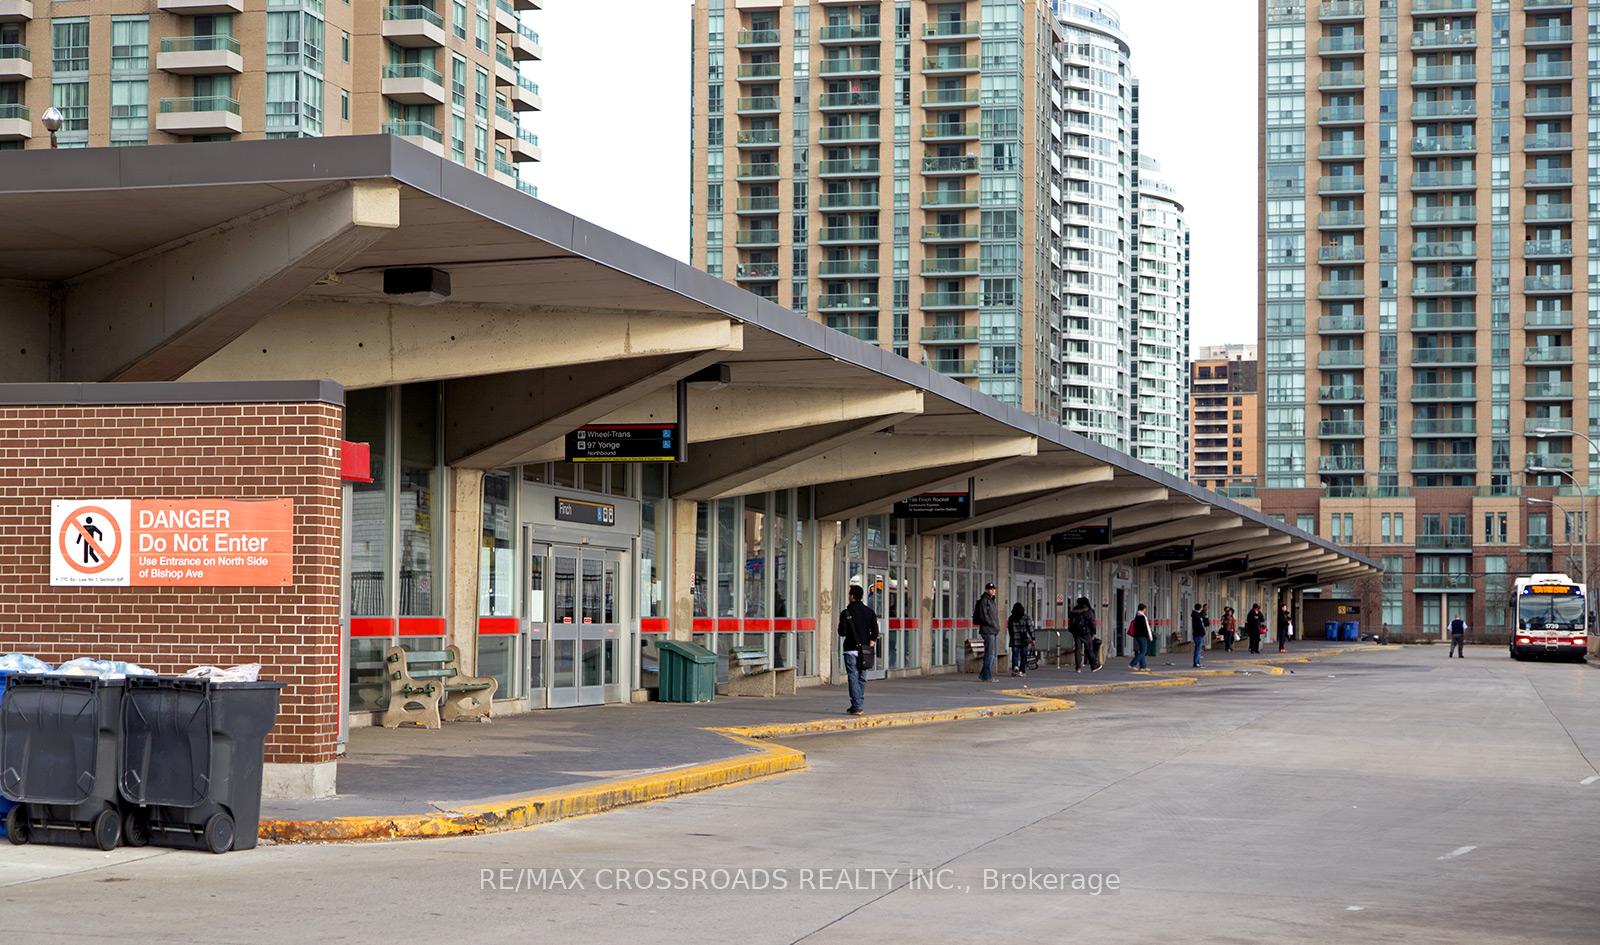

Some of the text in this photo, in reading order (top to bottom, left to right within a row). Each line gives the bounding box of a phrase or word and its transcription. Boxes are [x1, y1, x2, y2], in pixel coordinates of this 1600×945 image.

[587, 430, 631, 438] Wheel-Trans
[587, 441, 620, 450] 97 Yonge
[139, 509, 230, 529] DANGER
[139, 533, 268, 552] Do Not Enter
[139, 556, 268, 566] Use Entrance on North Side
[139, 569, 204, 580] of Bishop Ave
